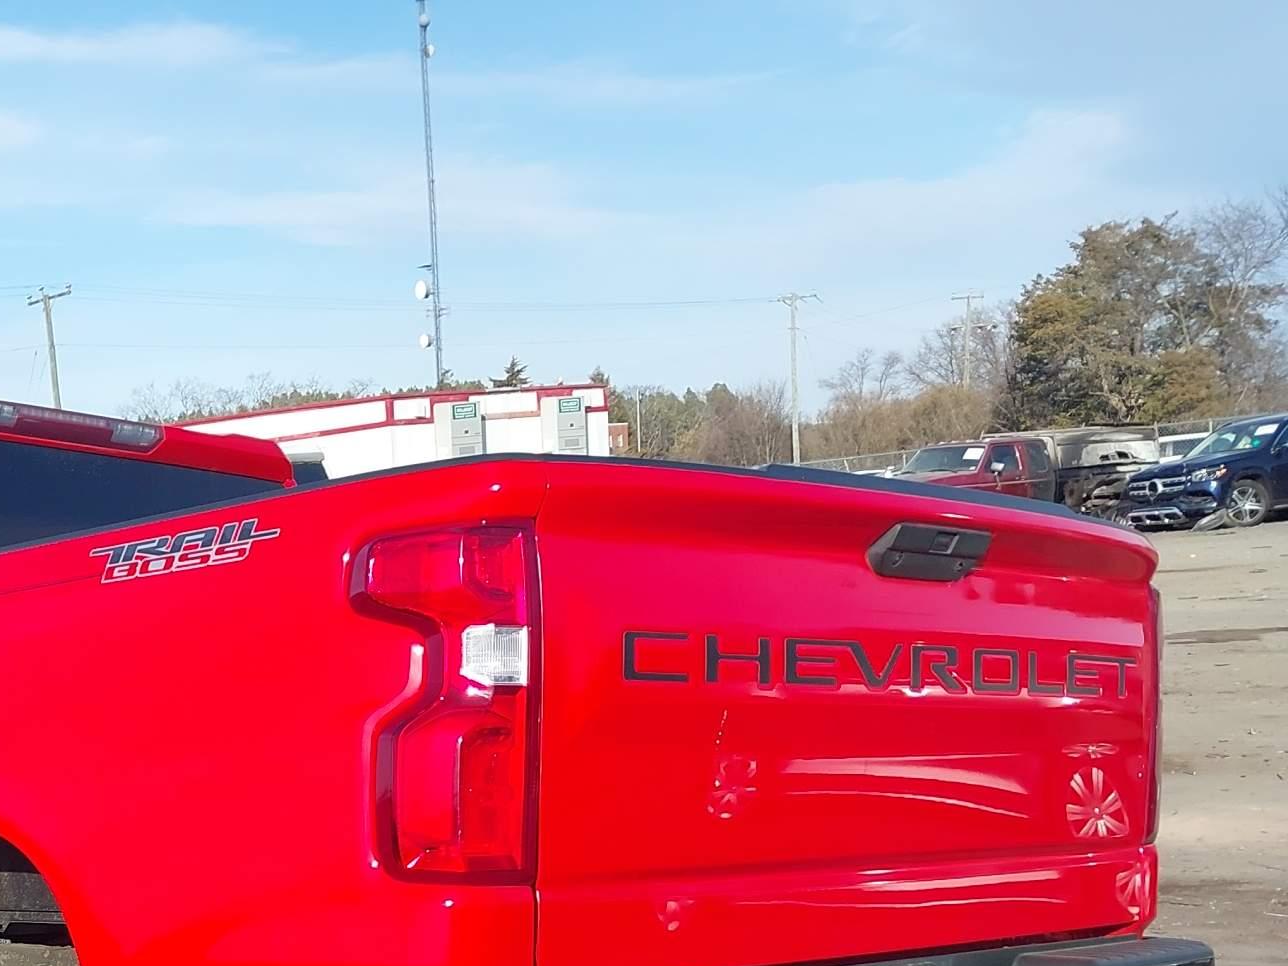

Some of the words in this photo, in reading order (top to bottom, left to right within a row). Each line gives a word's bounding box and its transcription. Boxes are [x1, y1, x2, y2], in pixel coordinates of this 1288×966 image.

[90, 518, 280, 563] TRAIL
[101, 542, 251, 583] BOSS
[623, 631, 1137, 698] CHEVROLET
